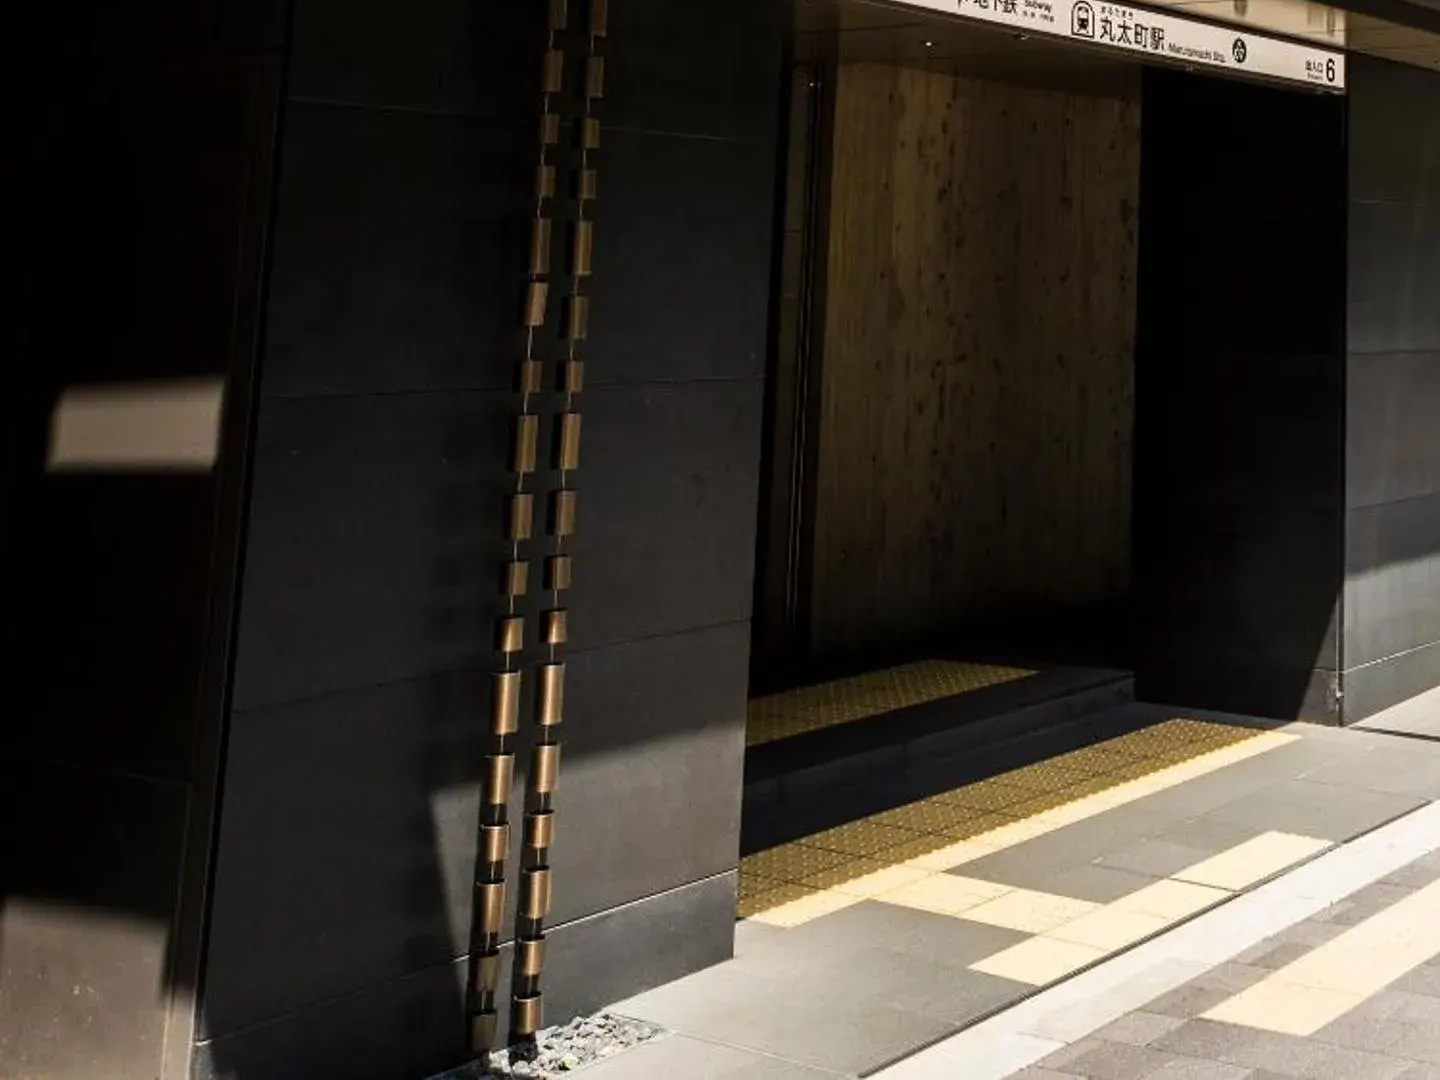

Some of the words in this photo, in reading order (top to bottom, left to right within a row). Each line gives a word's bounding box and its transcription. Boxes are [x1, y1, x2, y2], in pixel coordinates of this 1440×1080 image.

[1100, 16, 1165, 51] 丸太町駅
[1326, 58, 1335, 82] 6
